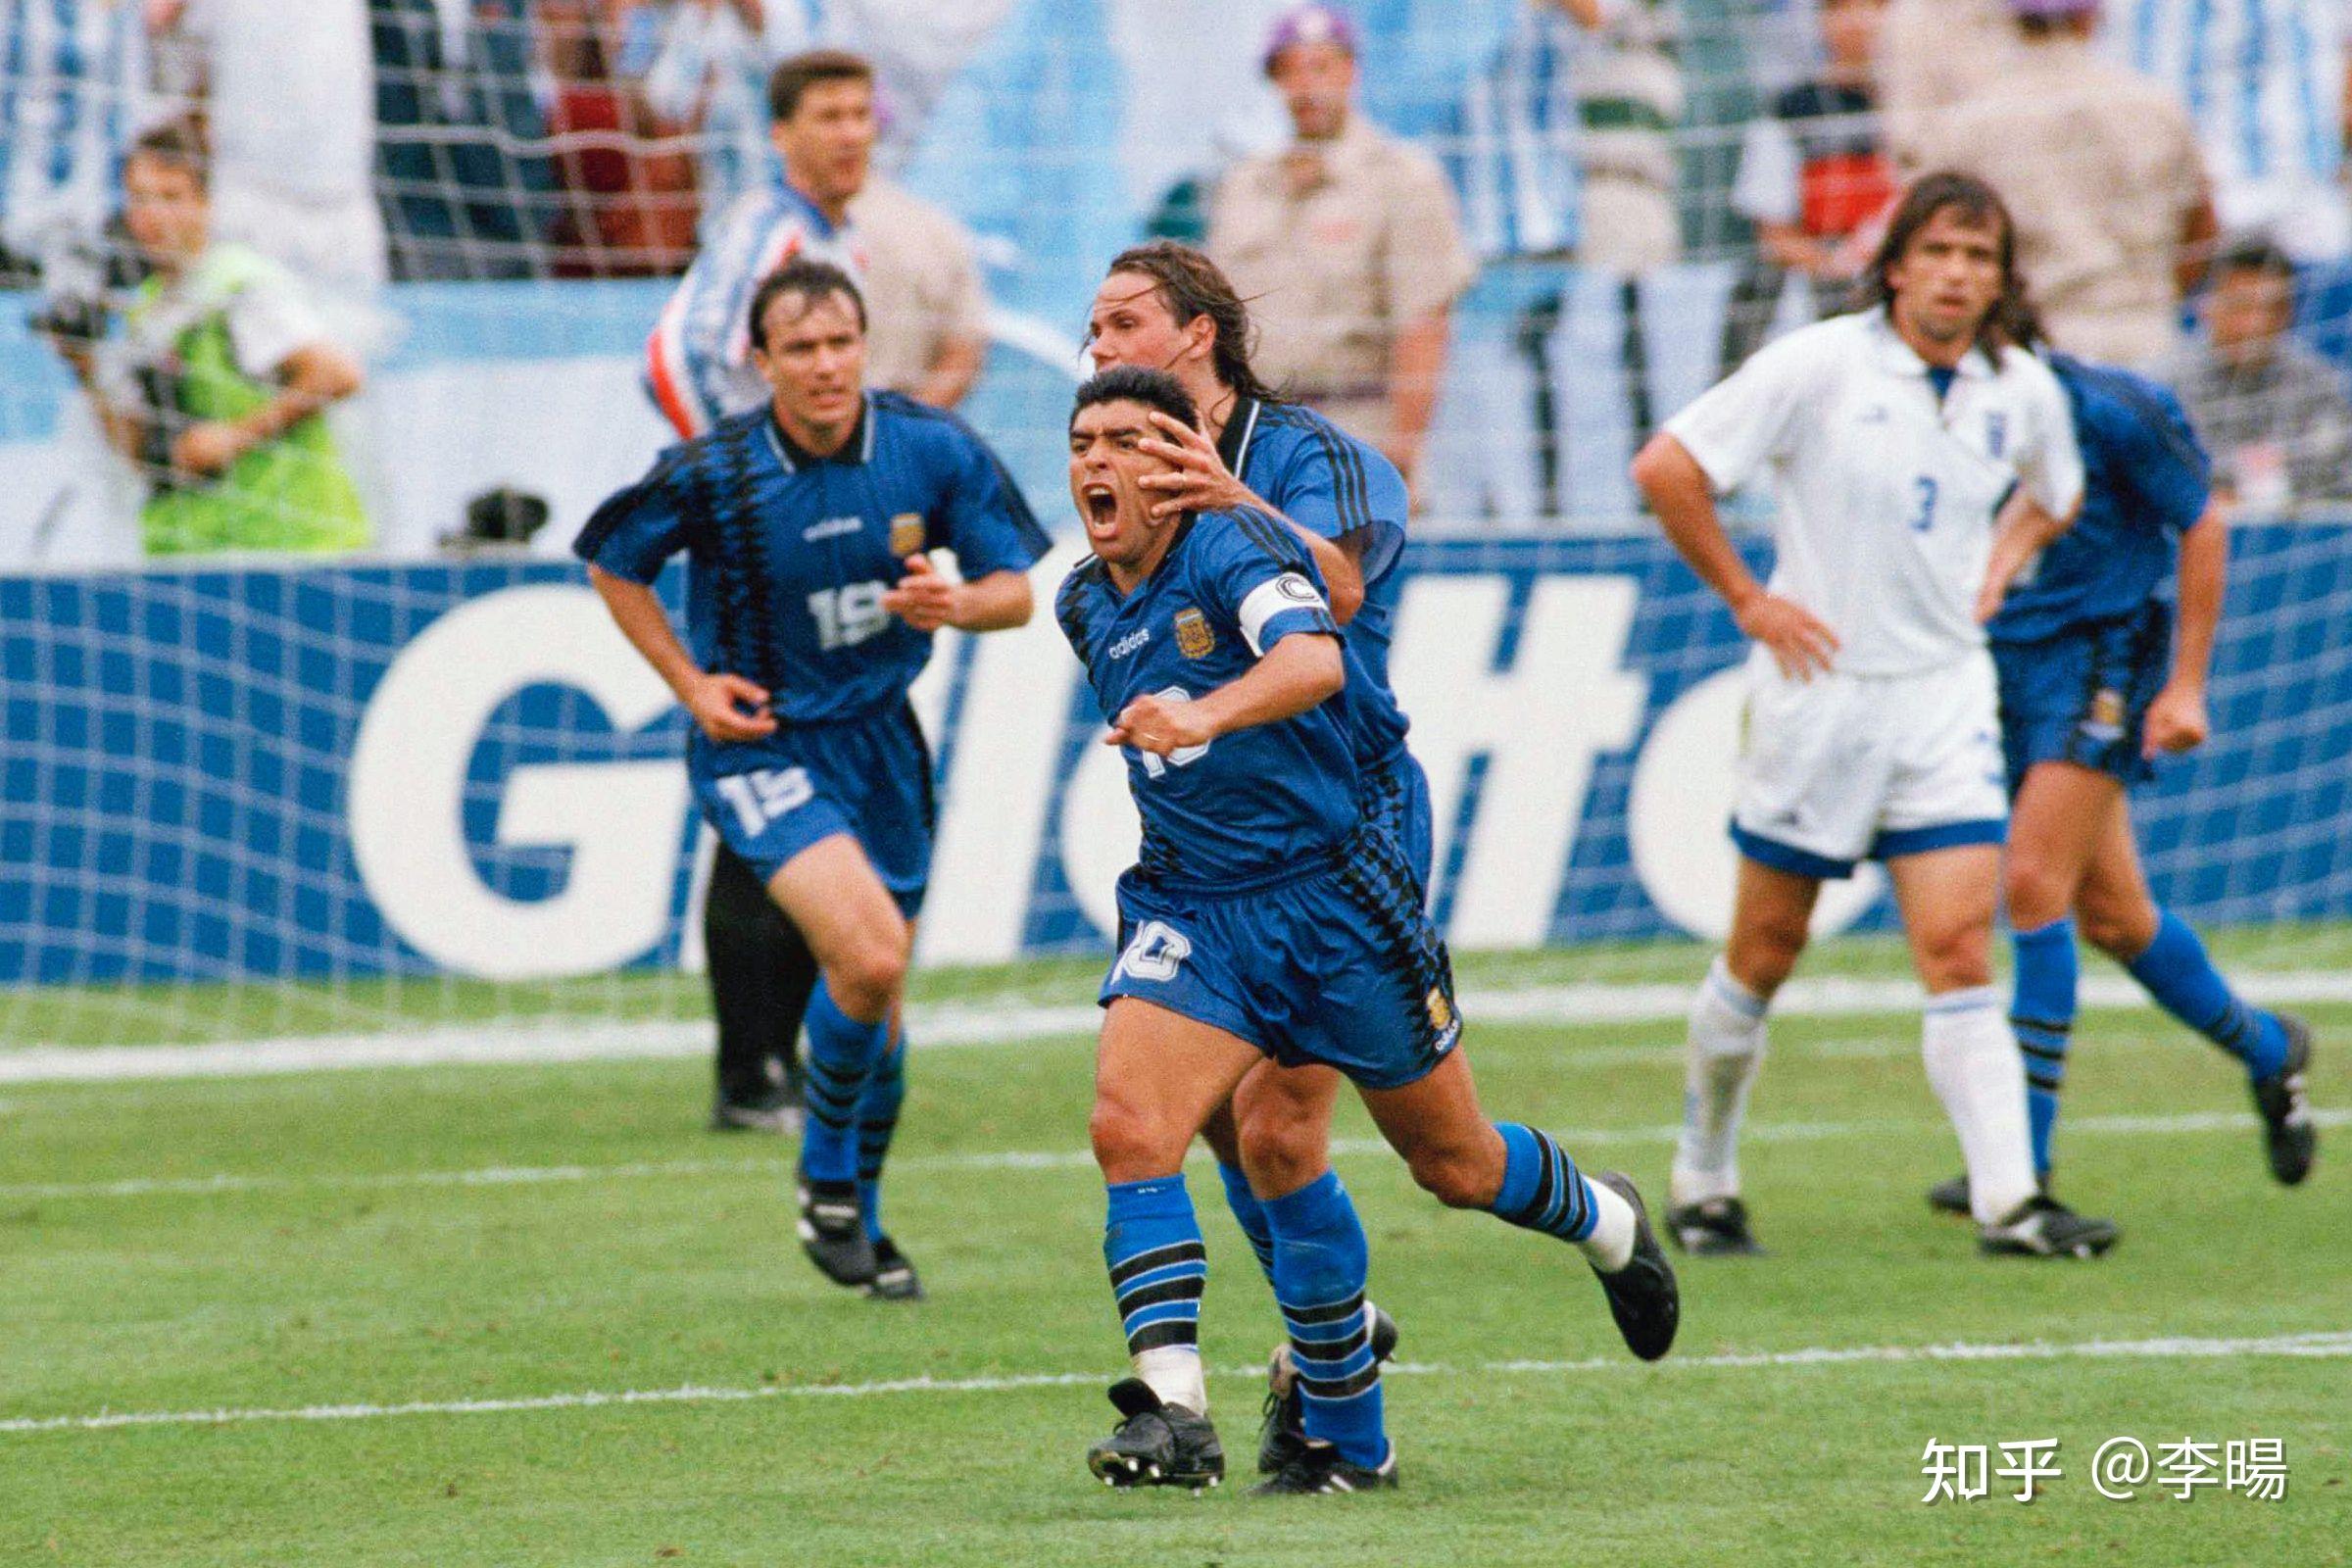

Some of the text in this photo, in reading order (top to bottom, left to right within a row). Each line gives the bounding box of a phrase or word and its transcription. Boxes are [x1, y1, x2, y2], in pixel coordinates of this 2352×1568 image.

[1910, 474, 1938, 532] 3
[807, 579, 893, 652] 19
[1108, 627, 1150, 660] adidas
